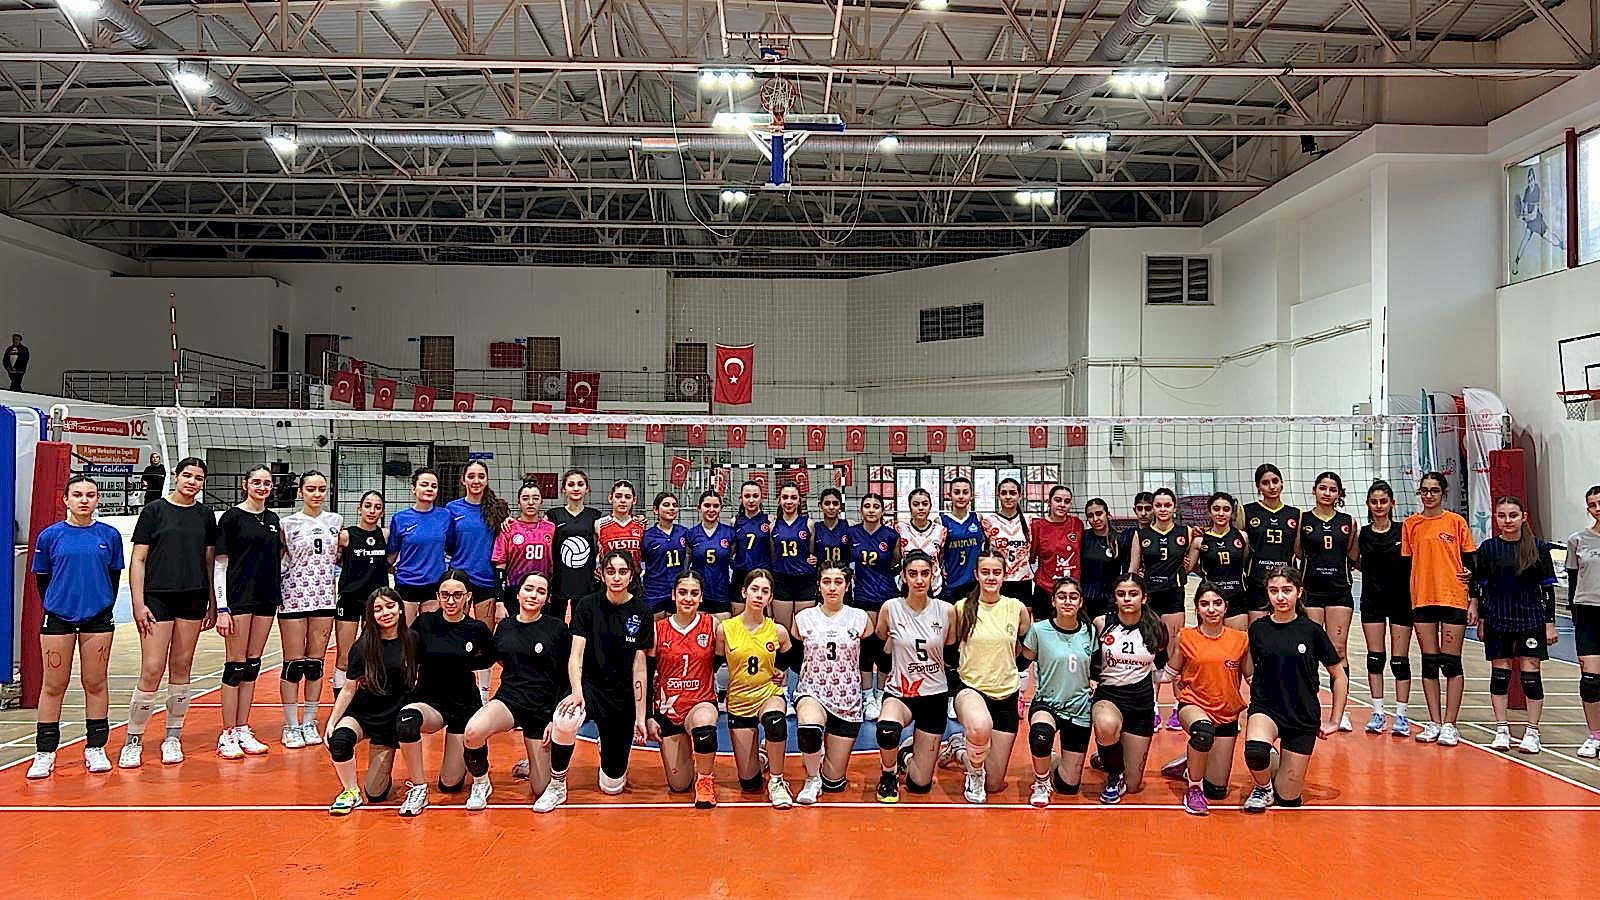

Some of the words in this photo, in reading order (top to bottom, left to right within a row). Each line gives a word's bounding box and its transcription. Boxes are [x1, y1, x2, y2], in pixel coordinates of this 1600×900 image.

[746, 534, 754, 549] 7
[1266, 529, 1283, 544] 53
[1323, 536, 1333, 549] 8
[313, 538, 323, 554] 9
[525, 544, 544, 559] 80
[608, 540, 640, 550] VESTEL
[781, 540, 798, 556] 13
[666, 551, 680, 567] 11
[706, 552, 715, 564] 5
[861, 551, 878, 566] 12
[959, 550, 966, 565] 3
[1008, 550, 1016, 562] 5
[1159, 547, 1168, 561] 3
[1217, 551, 1231, 565] 19
[826, 641, 837, 660] 3
[915, 638, 929, 661] 5
[1122, 641, 1135, 655] 21
[682, 654, 689, 677] 1
[747, 656, 759, 676] 8
[1067, 654, 1078, 672] 6
